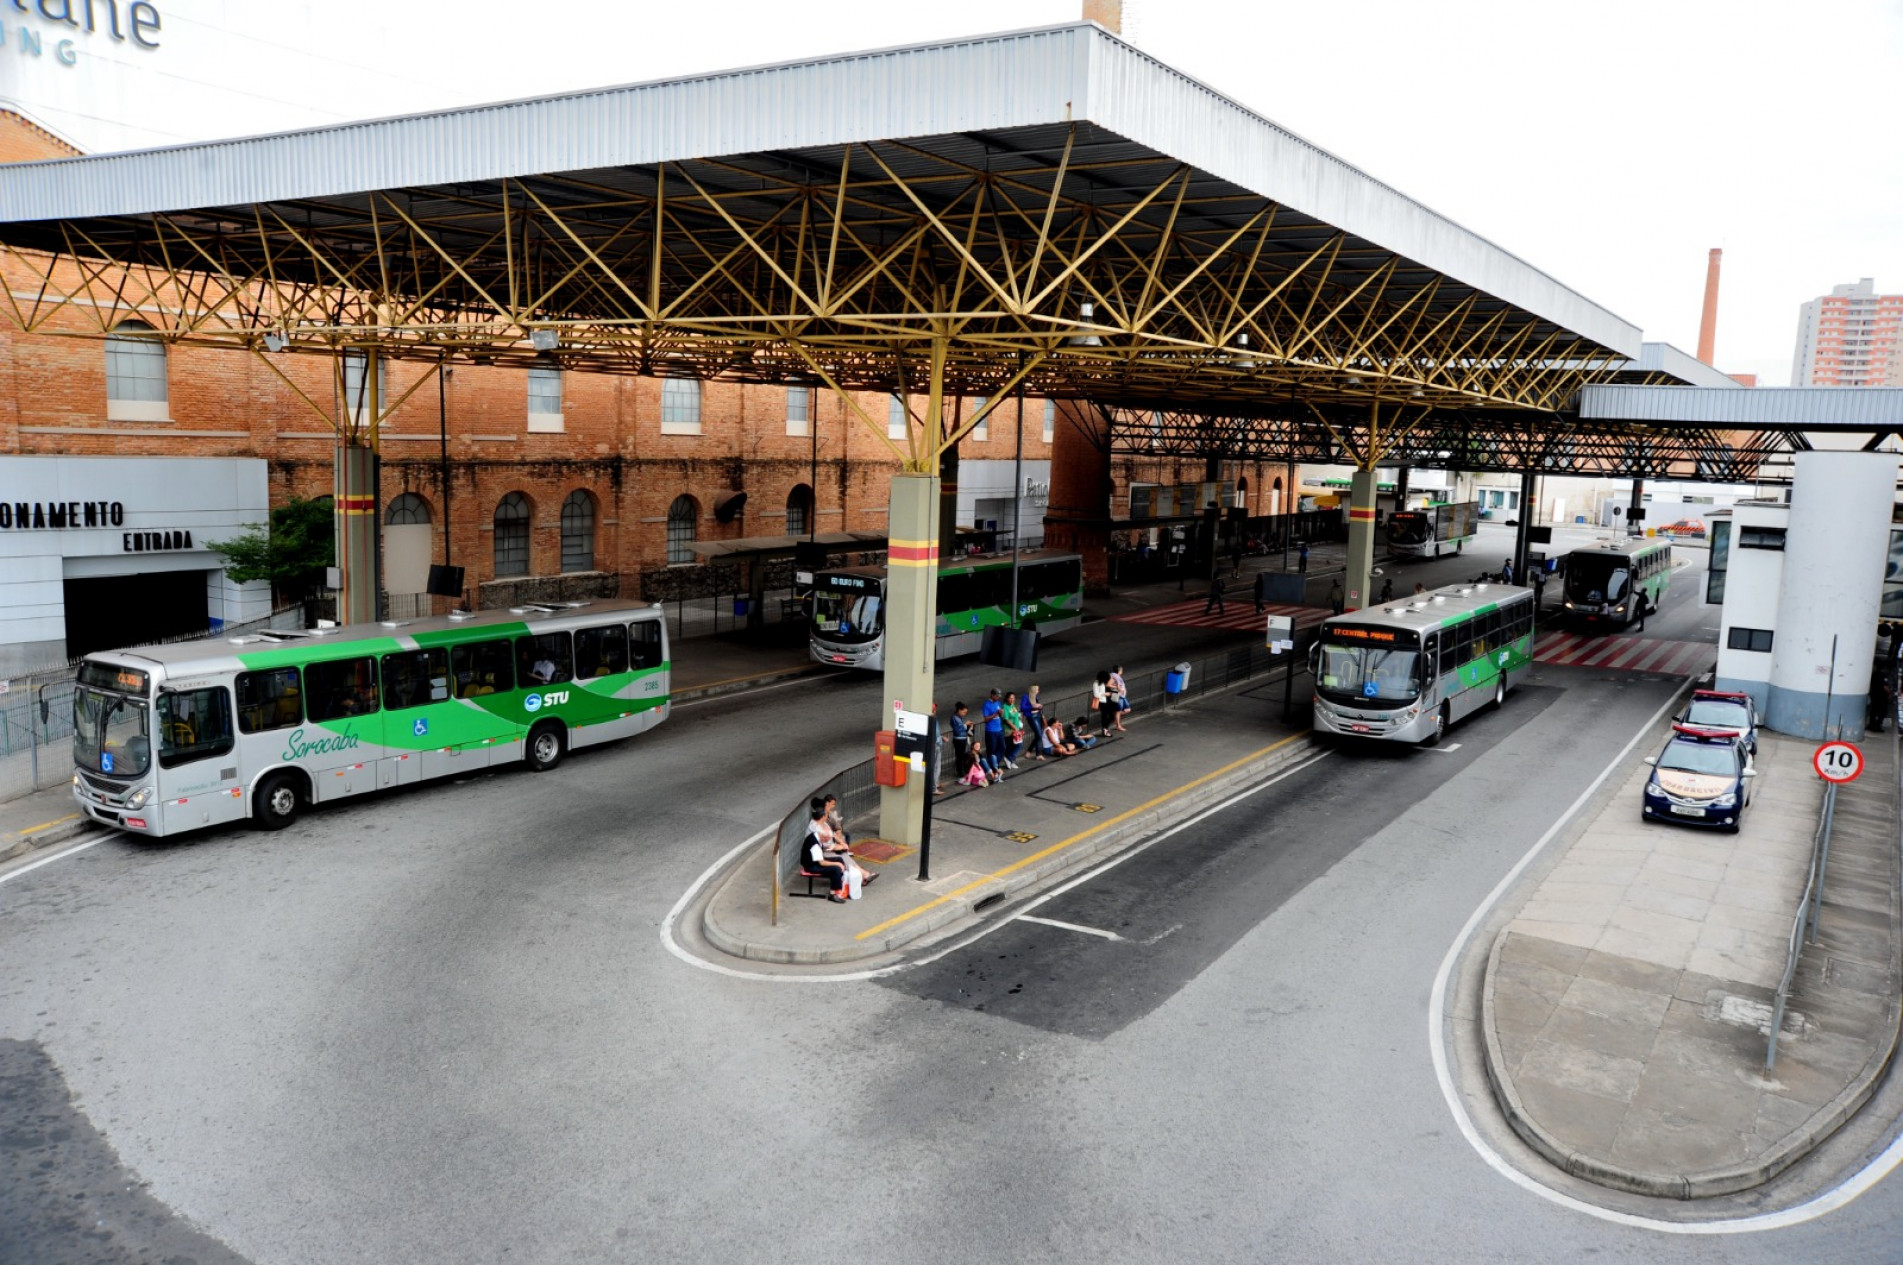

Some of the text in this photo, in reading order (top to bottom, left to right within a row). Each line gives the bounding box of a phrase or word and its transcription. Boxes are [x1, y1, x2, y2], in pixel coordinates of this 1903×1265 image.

[123, 531, 193, 552] ENTRADA
[543, 690, 570, 707] STU
[898, 717, 905, 728] E
[282, 722, 359, 761] Sorocaba
[1825, 750, 1853, 768] 10
